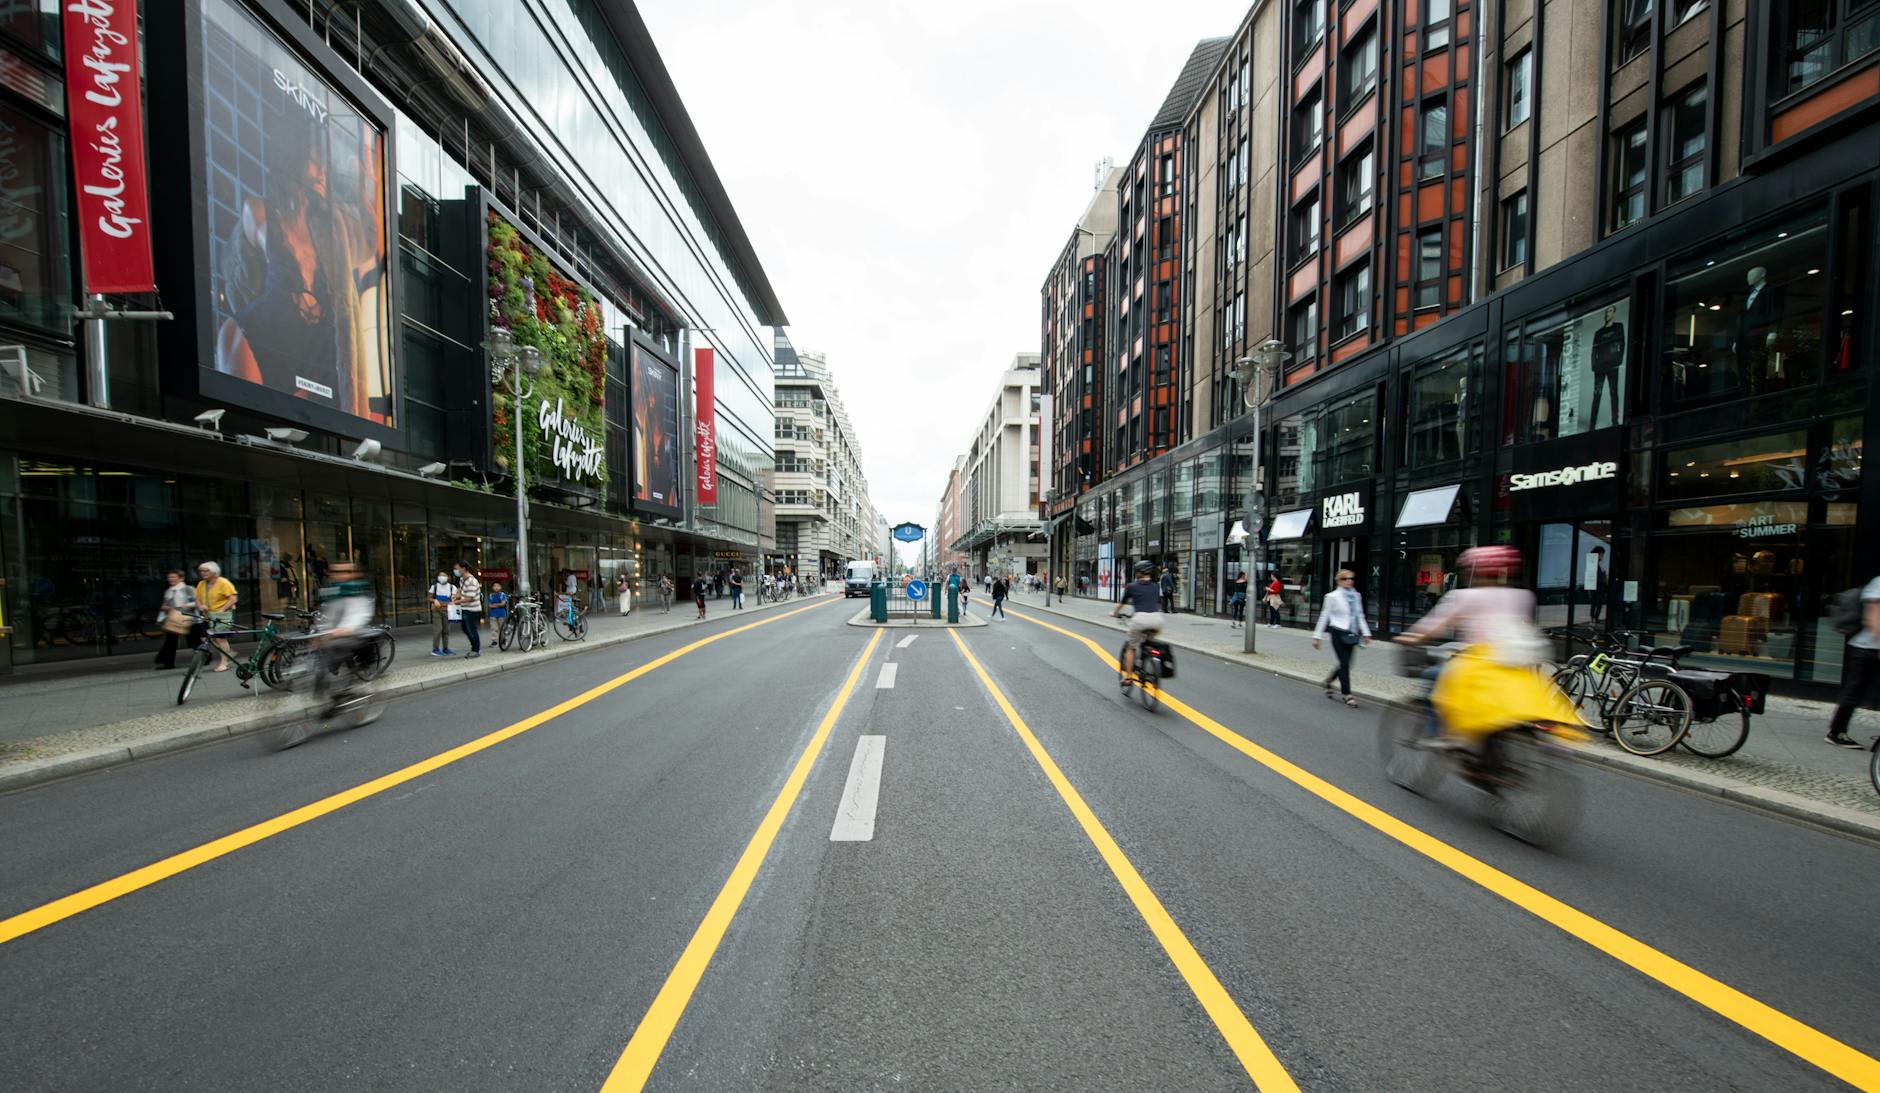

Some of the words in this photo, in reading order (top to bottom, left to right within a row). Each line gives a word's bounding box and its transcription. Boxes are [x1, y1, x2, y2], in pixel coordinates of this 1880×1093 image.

[68, 0, 131, 107] Lafayet
[84, 116, 142, 239] Galeries
[540, 397, 586, 446] Galeries
[697, 420, 713, 457] Lafayette
[553, 434, 603, 481] Lafayette
[699, 459, 714, 490] Galeries
[1509, 461, 1617, 491] Samsonite
[1323, 491, 1364, 518] KARL
[905, 526, 912, 535] U
[1322, 513, 1364, 528] LAGERFELD
[1740, 523, 1797, 538] SUMMER
[1748, 514, 1775, 527] ART
